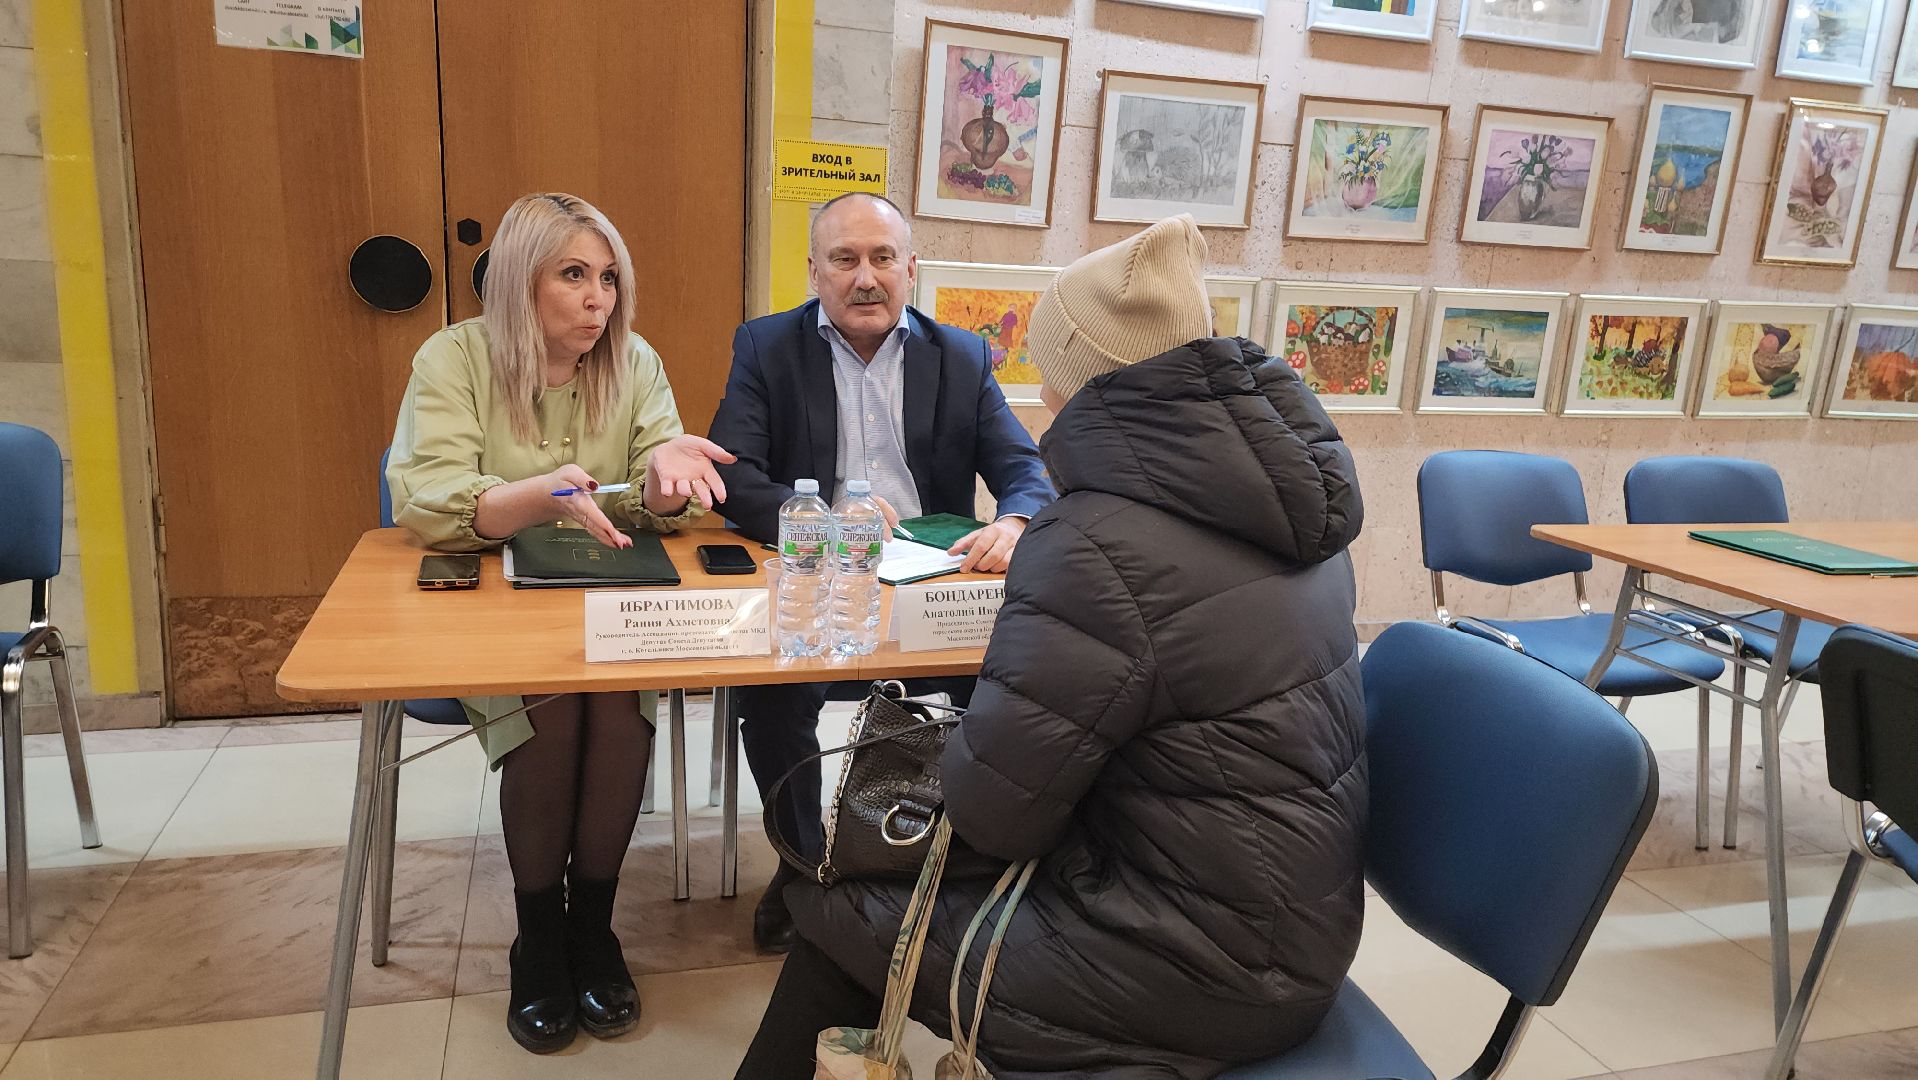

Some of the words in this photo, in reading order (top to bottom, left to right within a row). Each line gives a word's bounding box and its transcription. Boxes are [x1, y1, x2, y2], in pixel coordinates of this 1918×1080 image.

[812, 153, 842, 166] ВХОД
[845, 156, 852, 165] В
[781, 166, 856, 181] ЗРИТЕЛЬНЫЙ
[859, 172, 881, 183] ЗАЛ
[786, 531, 828, 541] СЕНЕЖСКАЯ
[839, 532, 880, 542] СЕНЕЖСКАЯ
[925, 588, 1005, 603] БОНДАРЕН
[619, 598, 735, 613] ИБРАГИМОВА
[922, 606, 975, 619] Анатолий
[978, 606, 998, 616] Ива
[624, 618, 662, 629] Рания
[665, 617, 731, 627] Ахметовна
